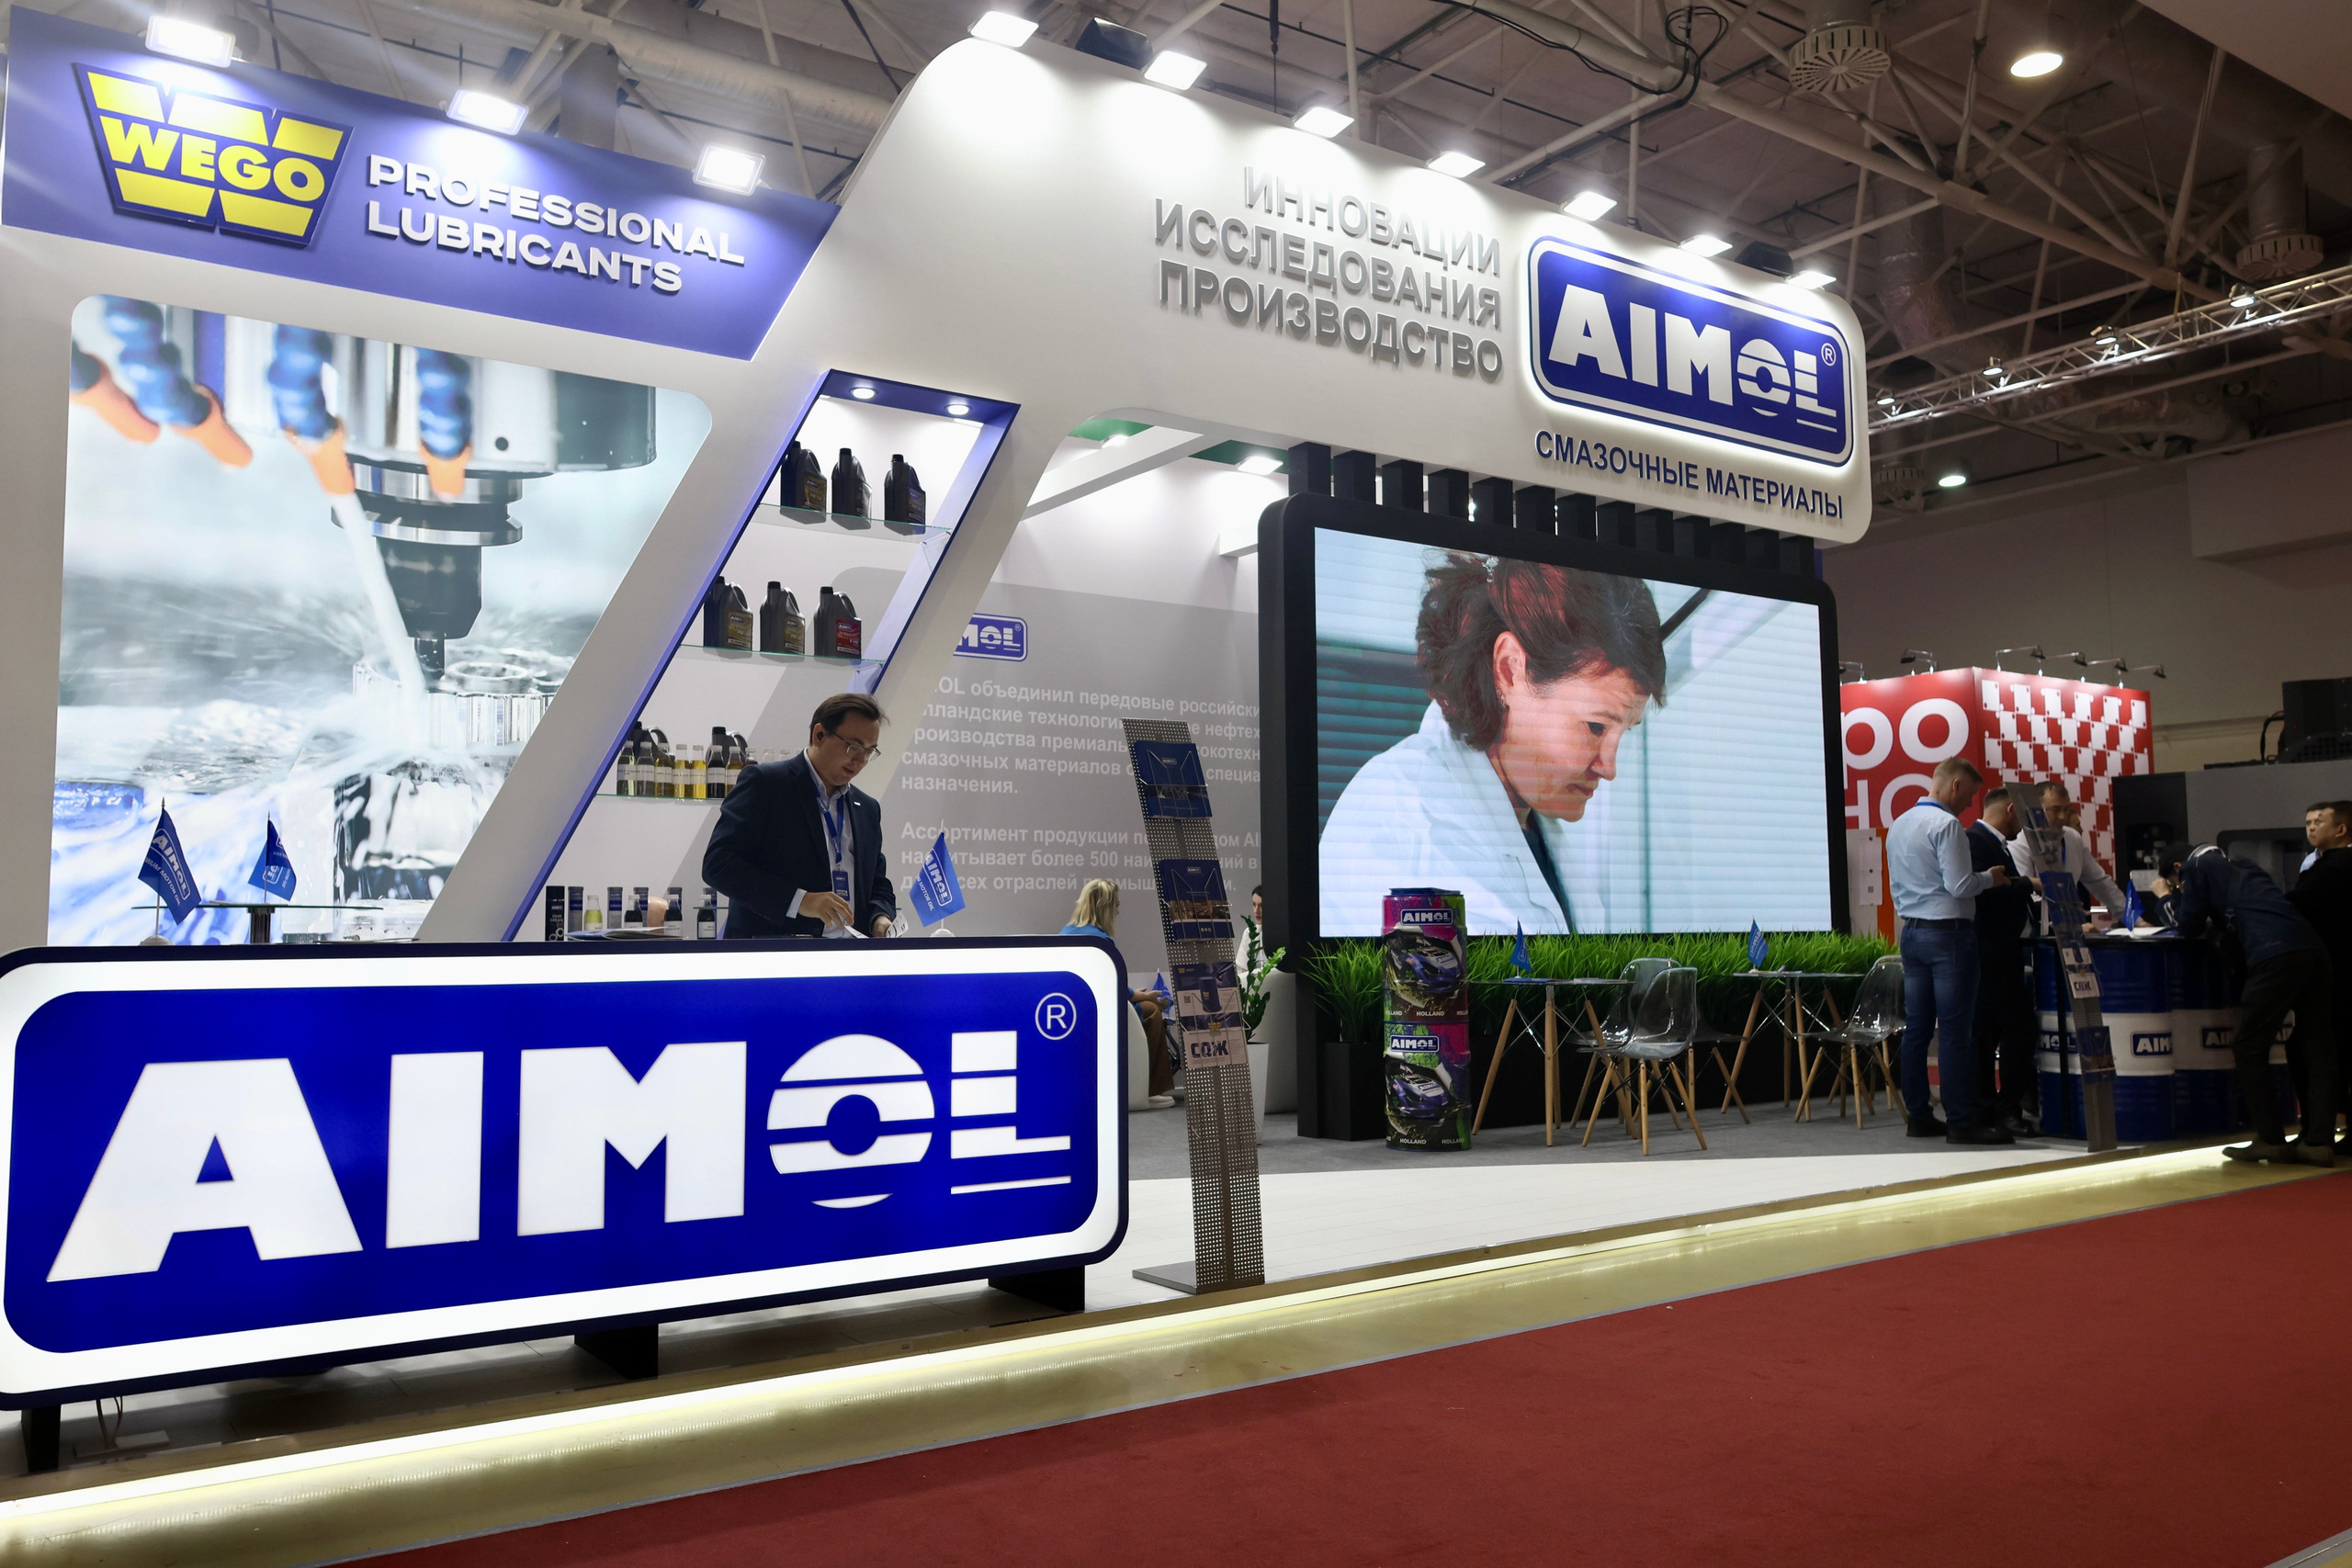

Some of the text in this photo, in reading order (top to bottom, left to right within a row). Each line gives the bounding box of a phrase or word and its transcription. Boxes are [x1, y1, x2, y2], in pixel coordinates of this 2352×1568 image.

[99, 115, 324, 202] WEGO
[369, 153, 745, 265] PROFESSIONAL
[1245, 165, 1500, 276] ИННОВАЦИИ
[368, 200, 683, 293] LUBRICANTS
[1155, 197, 1501, 330] ИССЛЕДОВАНИЯ
[1159, 258, 1504, 376] ПРОИЗВОДСТВО
[1548, 283, 1838, 434] AIMOL
[1535, 430, 1843, 519] СМАЗОЧНЫЕ МАТЕРИАЛЫ
[970, 681, 1074, 703] объединил
[1080, 691, 1174, 713] передовые
[902, 751, 1009, 770] смазочных
[1014, 757, 1121, 777] материалов
[1197, 745, 1261, 761] окотехн
[901, 776, 1019, 795] назначения.
[900, 821, 1028, 844] Ассортимент
[1033, 829, 1128, 847] продукции
[153, 834, 187, 896] AIMOL
[901, 850, 1026, 866] наитывает
[1031, 849, 1084, 867] более
[1090, 851, 1118, 867] 500
[925, 853, 948, 903] AIMOL
[159, 870, 176, 896] MOTOR
[919, 882, 932, 902] MOTOR
[993, 873, 1078, 893] отраслей
[1403, 912, 1451, 922] AIMOL
[1392, 1039, 1437, 1049] AIMOL
[45, 1031, 1072, 1283] AIMOL
